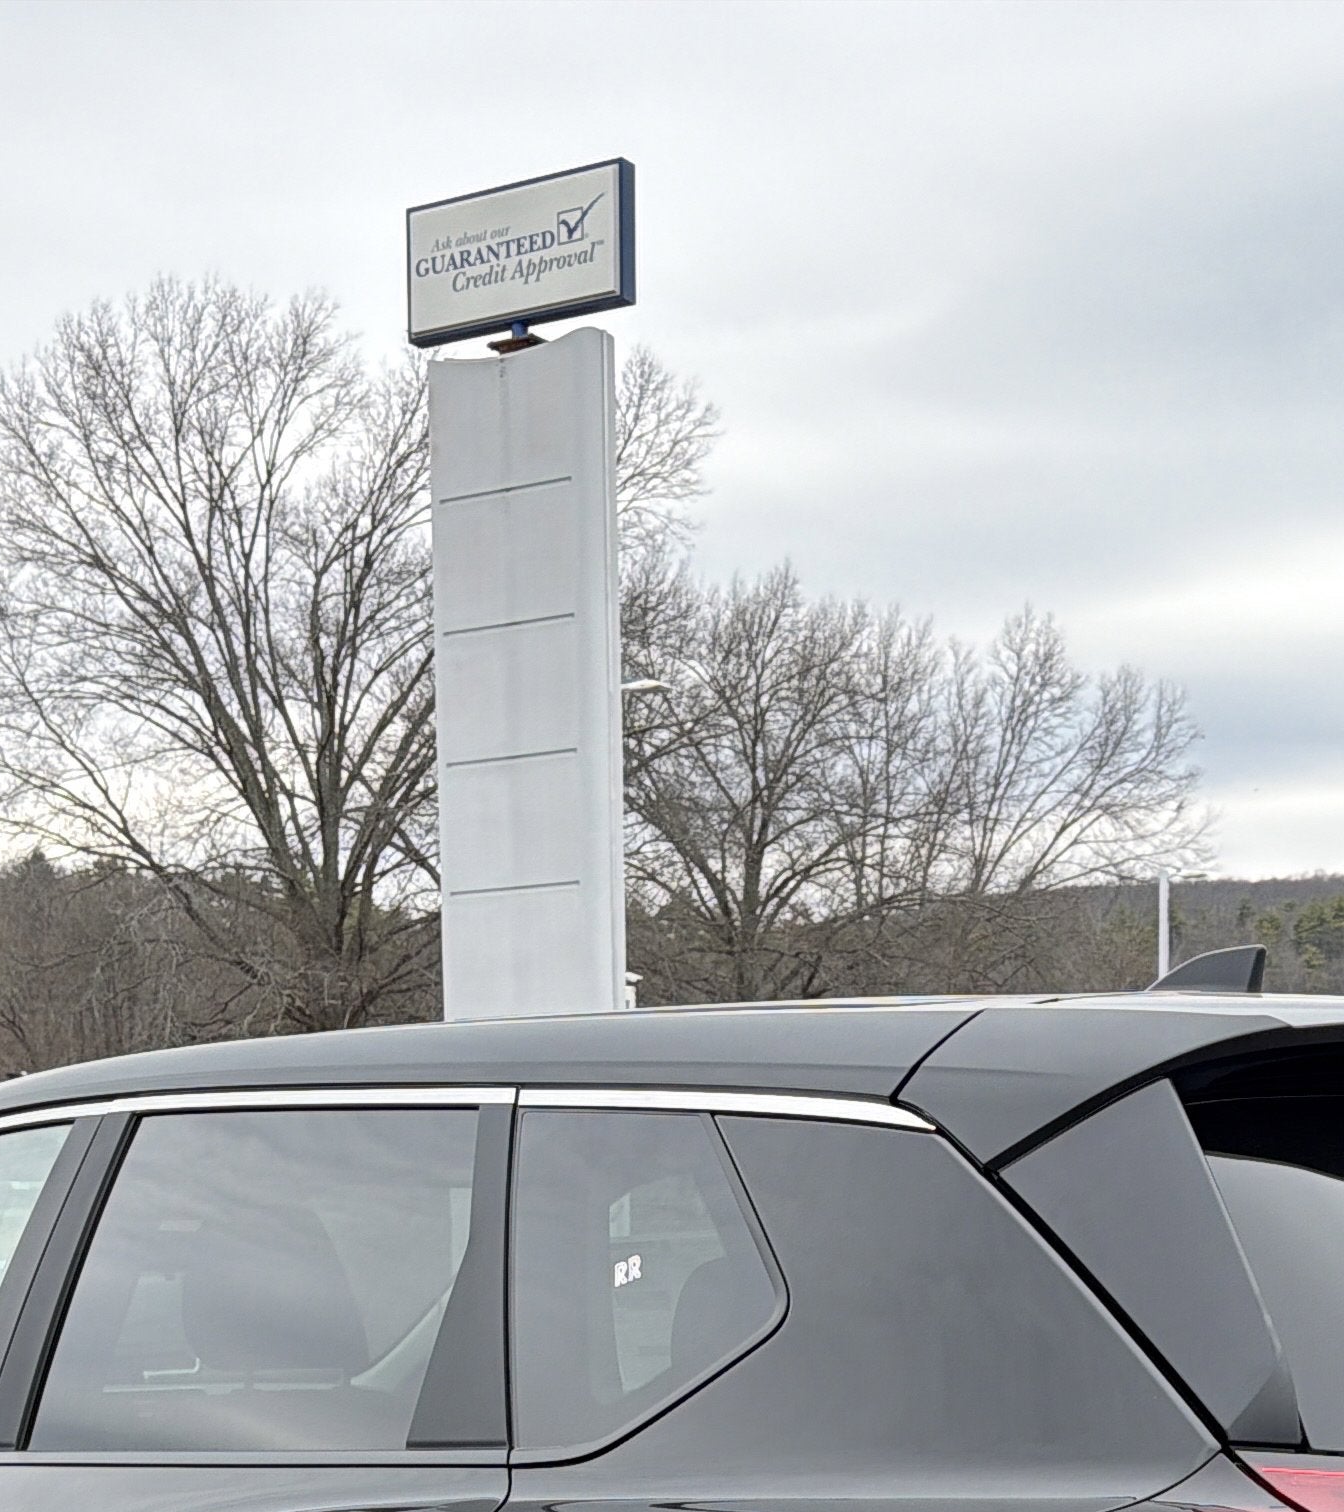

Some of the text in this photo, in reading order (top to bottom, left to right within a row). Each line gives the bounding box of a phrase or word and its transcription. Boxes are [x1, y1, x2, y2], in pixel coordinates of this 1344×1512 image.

[415, 230, 555, 278] GUARANTEED
[431, 226, 510, 253] Ask about our
[452, 262, 507, 293] Credit
